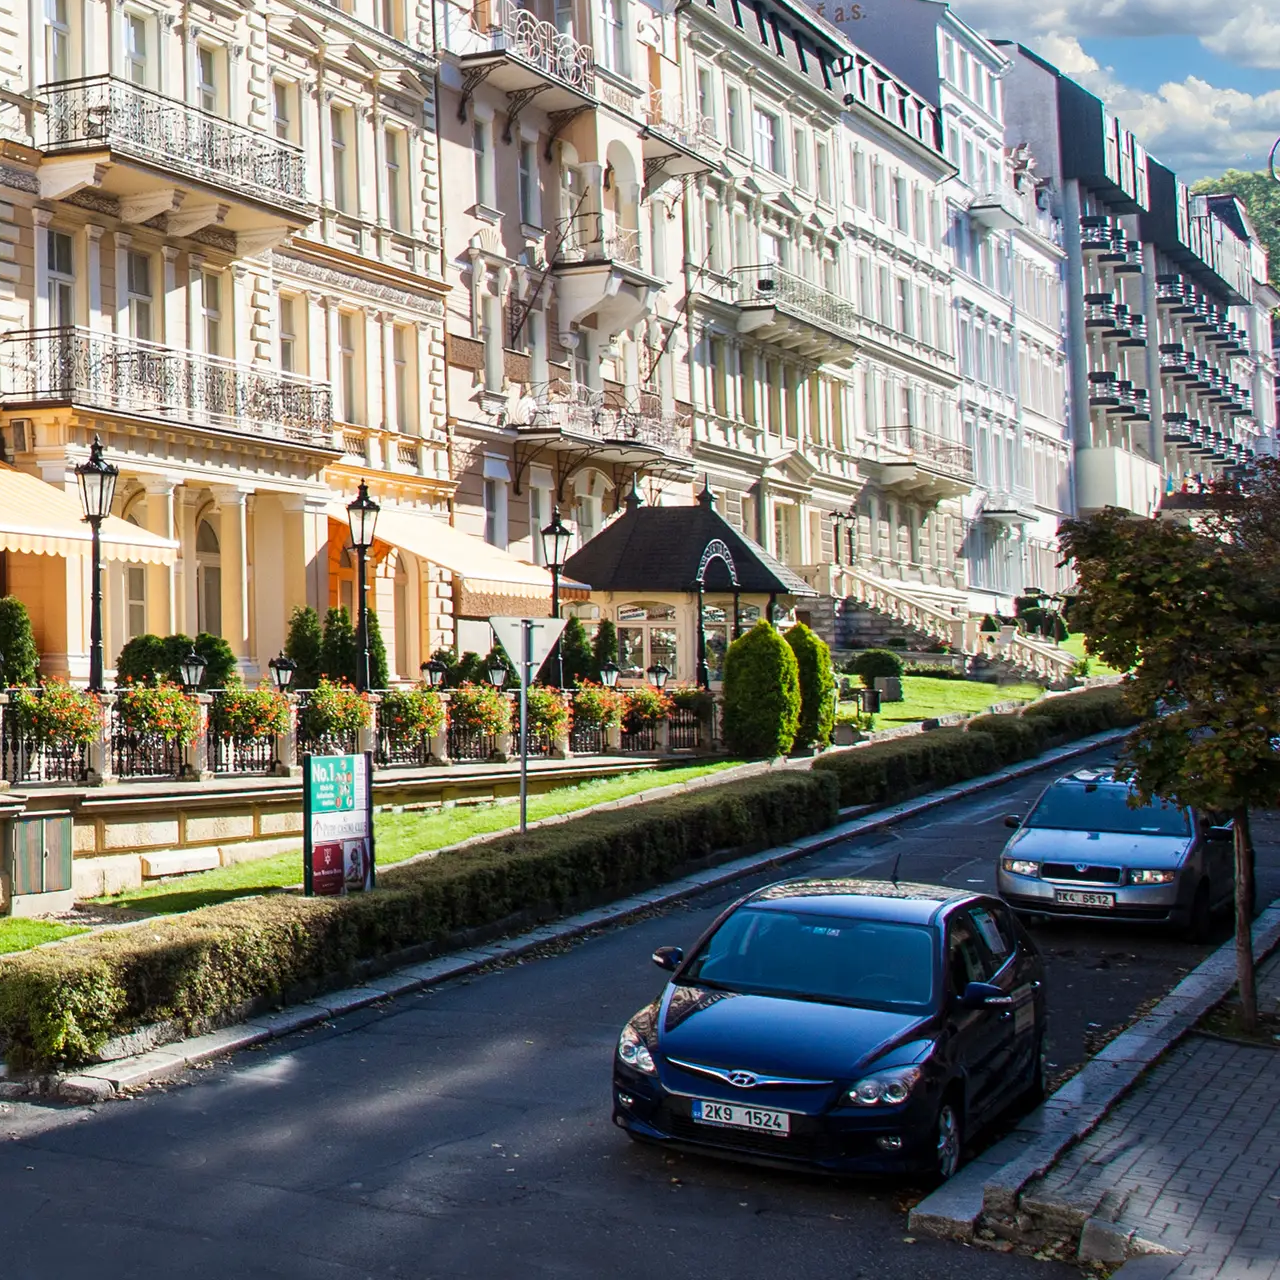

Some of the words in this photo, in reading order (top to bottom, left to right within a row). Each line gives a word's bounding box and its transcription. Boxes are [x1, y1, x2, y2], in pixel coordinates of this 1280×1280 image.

[313, 763, 334, 783] No.1
[704, 1104, 733, 1121] 2K9
[744, 1110, 782, 1129] 1524
